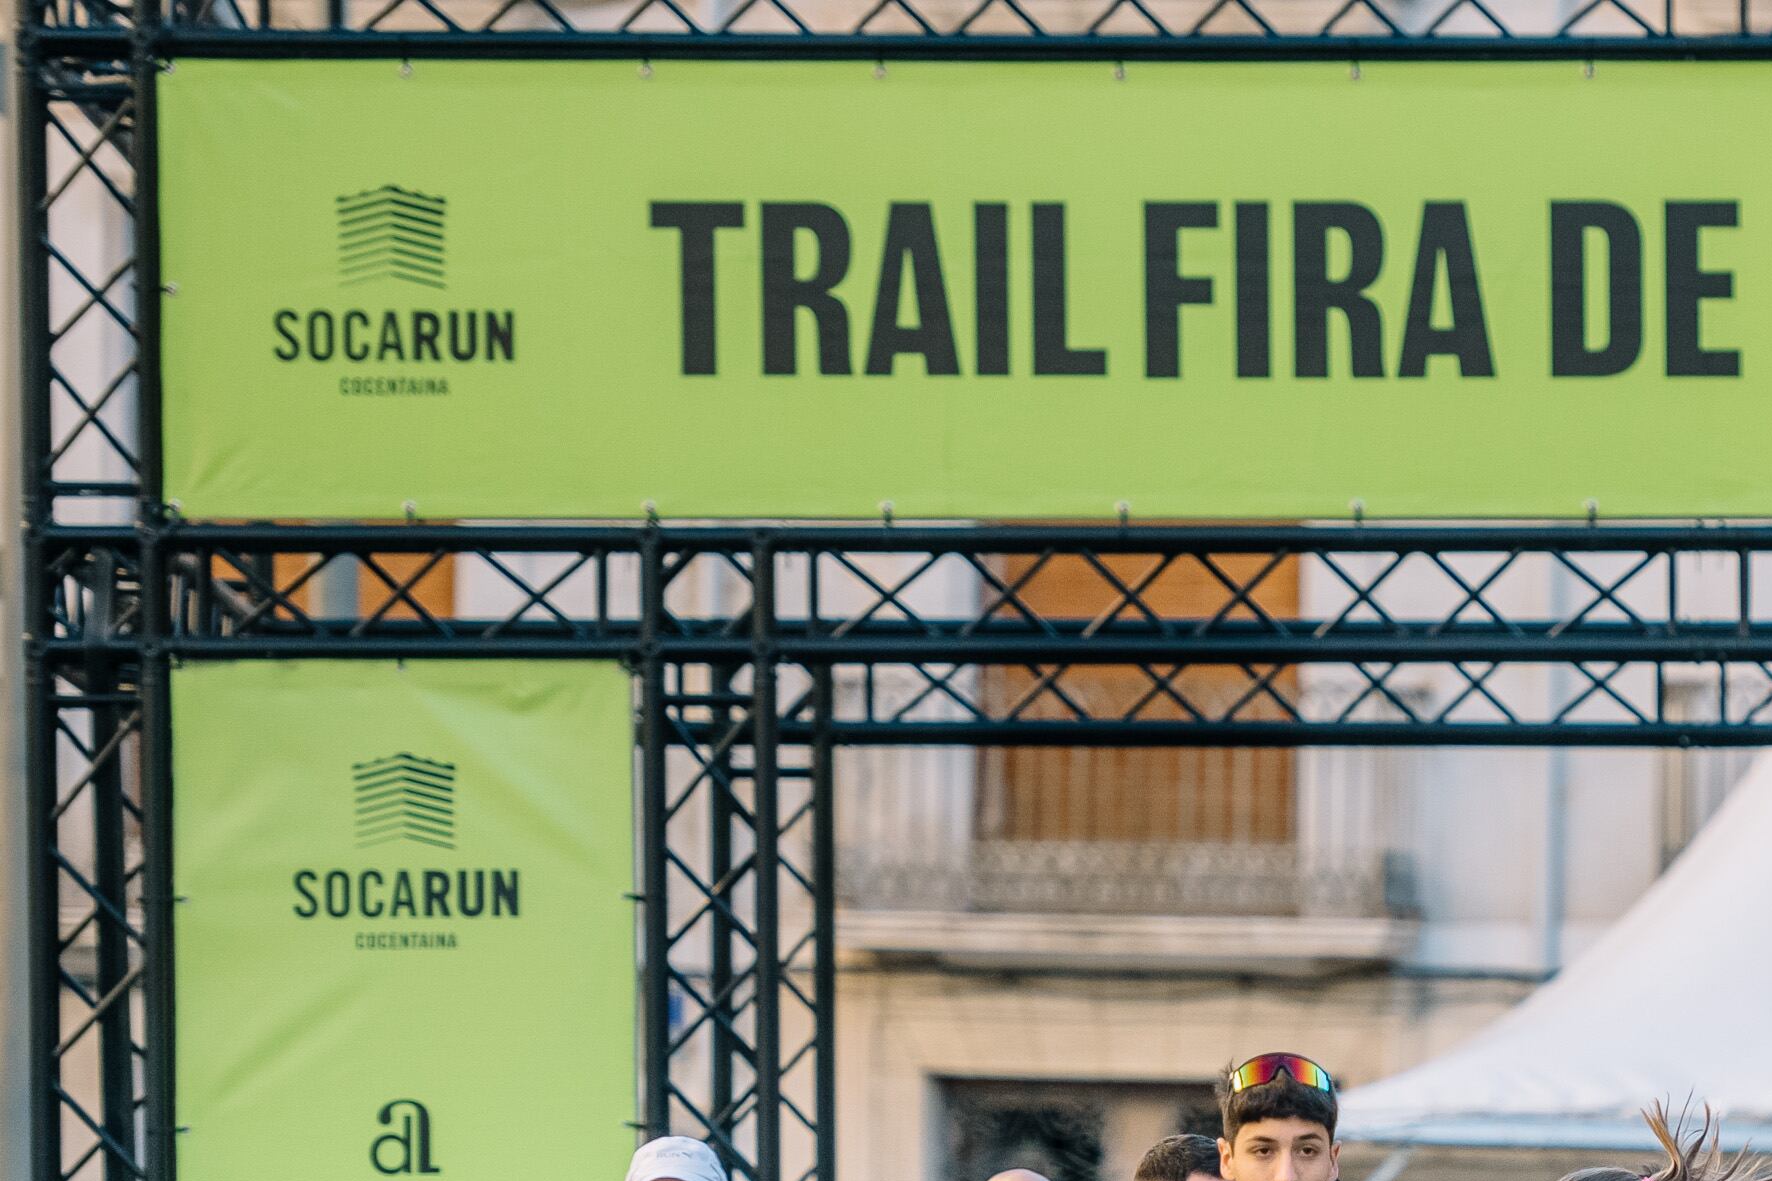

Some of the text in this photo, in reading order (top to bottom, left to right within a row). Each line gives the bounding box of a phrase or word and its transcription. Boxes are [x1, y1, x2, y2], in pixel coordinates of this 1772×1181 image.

[650, 201, 1107, 377] TRAIL
[1144, 201, 1496, 378] FIRA
[1551, 201, 1743, 378] DE
[274, 309, 515, 361] SOCARUN
[340, 377, 449, 396] COCENTAINA
[294, 869, 519, 918] SOCARUN
[355, 932, 457, 949] COCENTAINA
